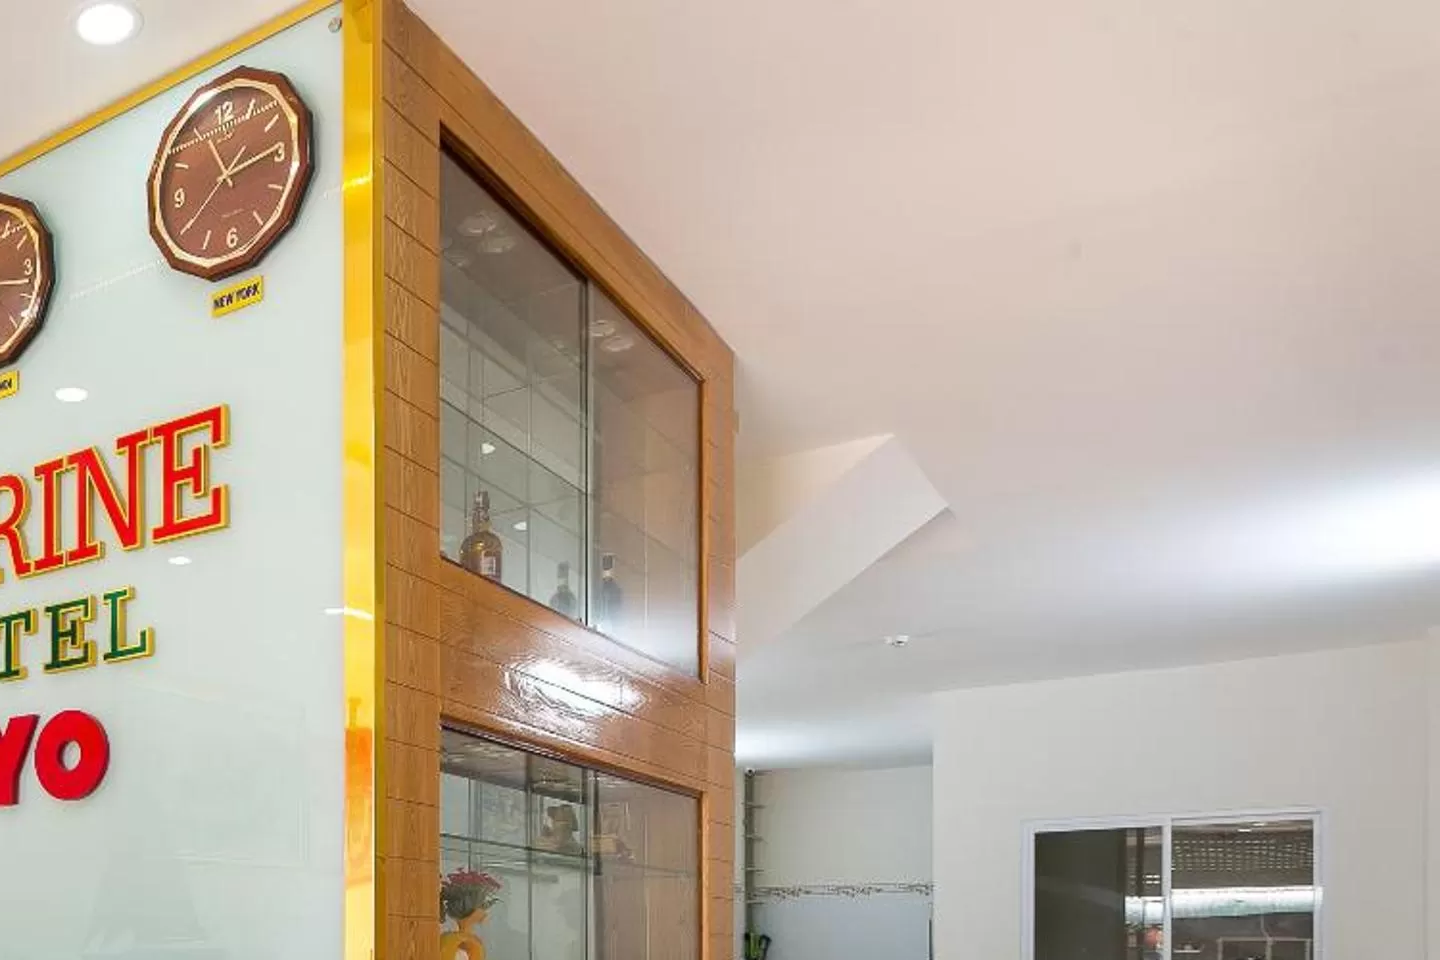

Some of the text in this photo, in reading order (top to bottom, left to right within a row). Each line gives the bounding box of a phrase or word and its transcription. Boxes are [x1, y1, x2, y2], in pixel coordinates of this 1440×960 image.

[215, 101, 233, 123] 12
[274, 142, 285, 162] 3
[174, 188, 185, 208] 9
[226, 227, 238, 248] 6
[24, 258, 33, 275] 3
[213, 293, 233, 307] NEW
